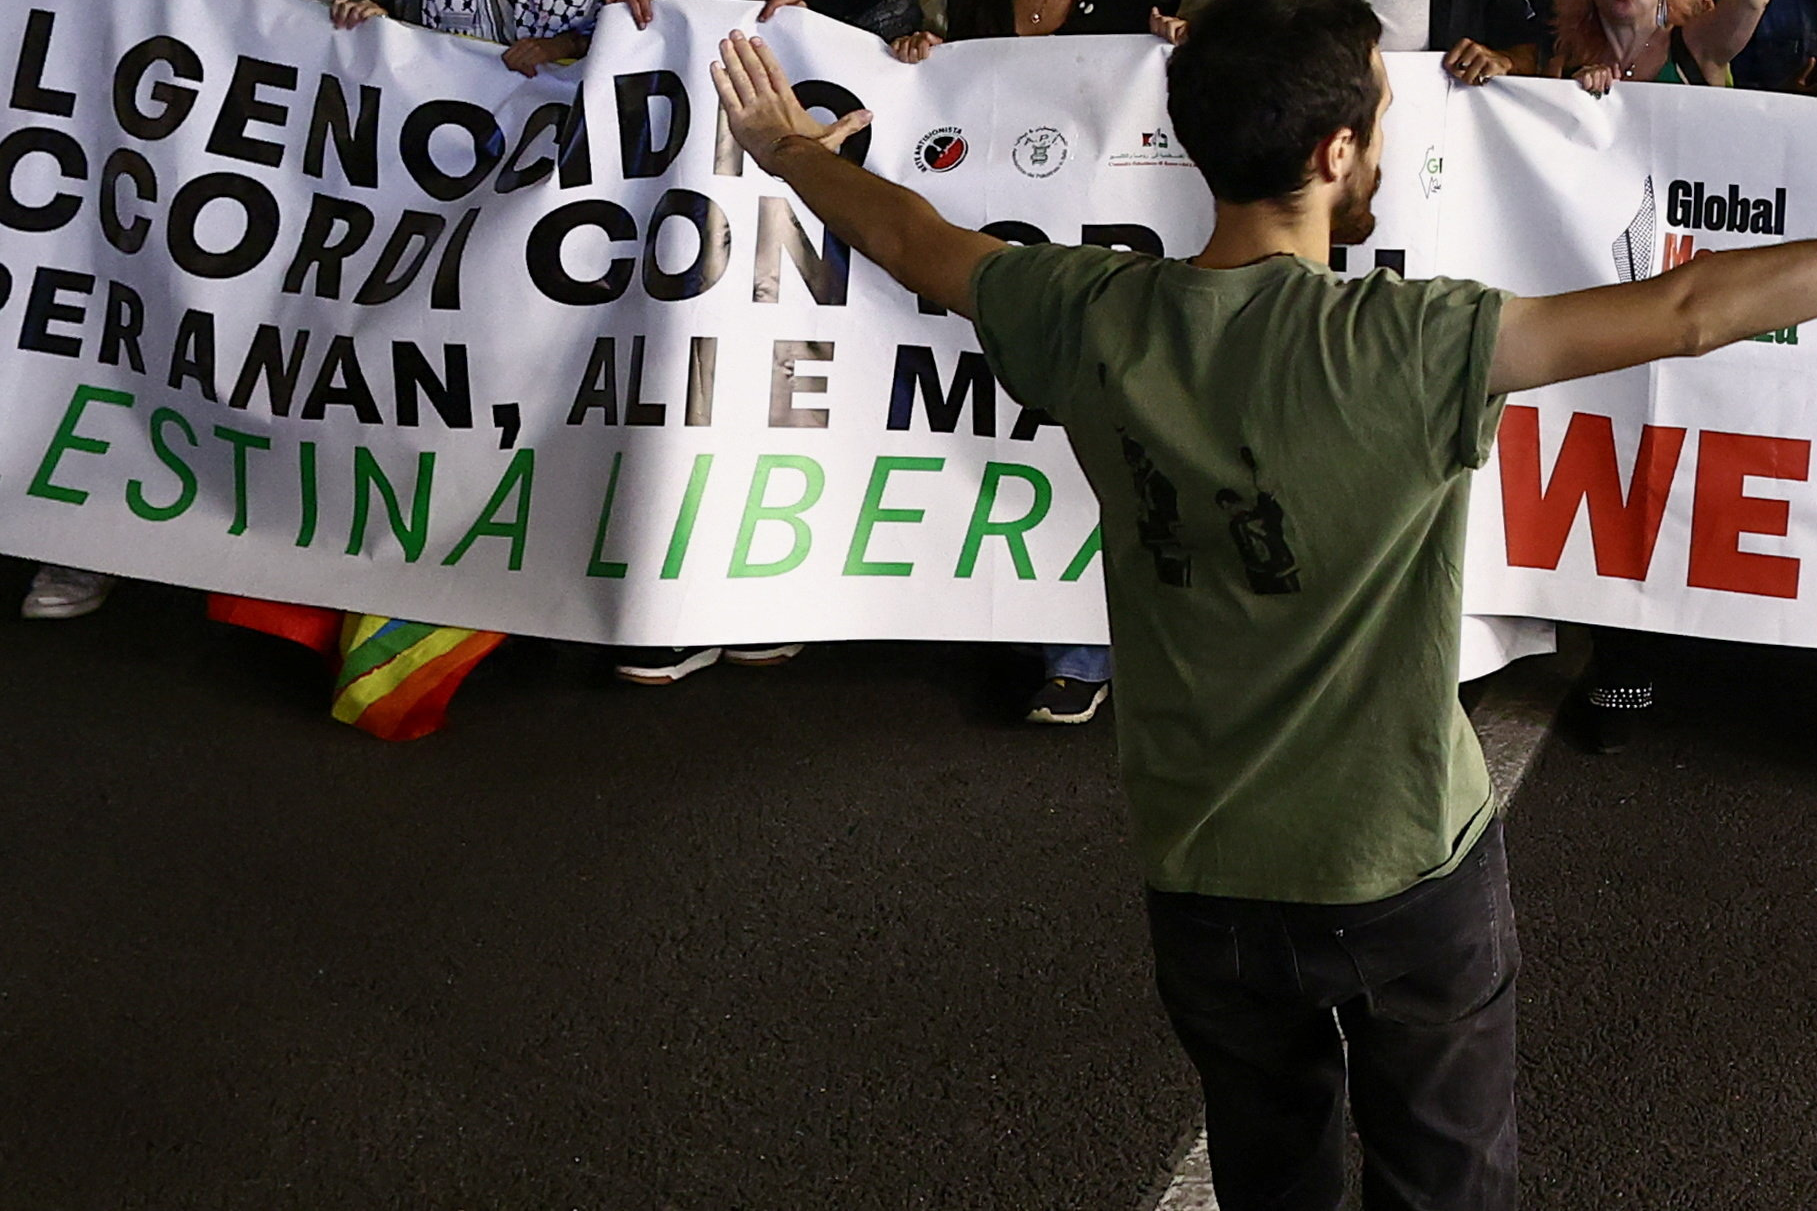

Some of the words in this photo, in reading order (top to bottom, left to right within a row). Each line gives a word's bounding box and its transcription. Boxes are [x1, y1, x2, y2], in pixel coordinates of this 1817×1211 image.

[10, 9, 76, 118] L
[526, 188, 851, 306] CON
[1667, 180, 1786, 235] Global
[169, 310, 520, 449] ANAN,
[567, 336, 719, 428] ALI
[768, 340, 836, 429] E
[1497, 404, 1812, 599] WE
